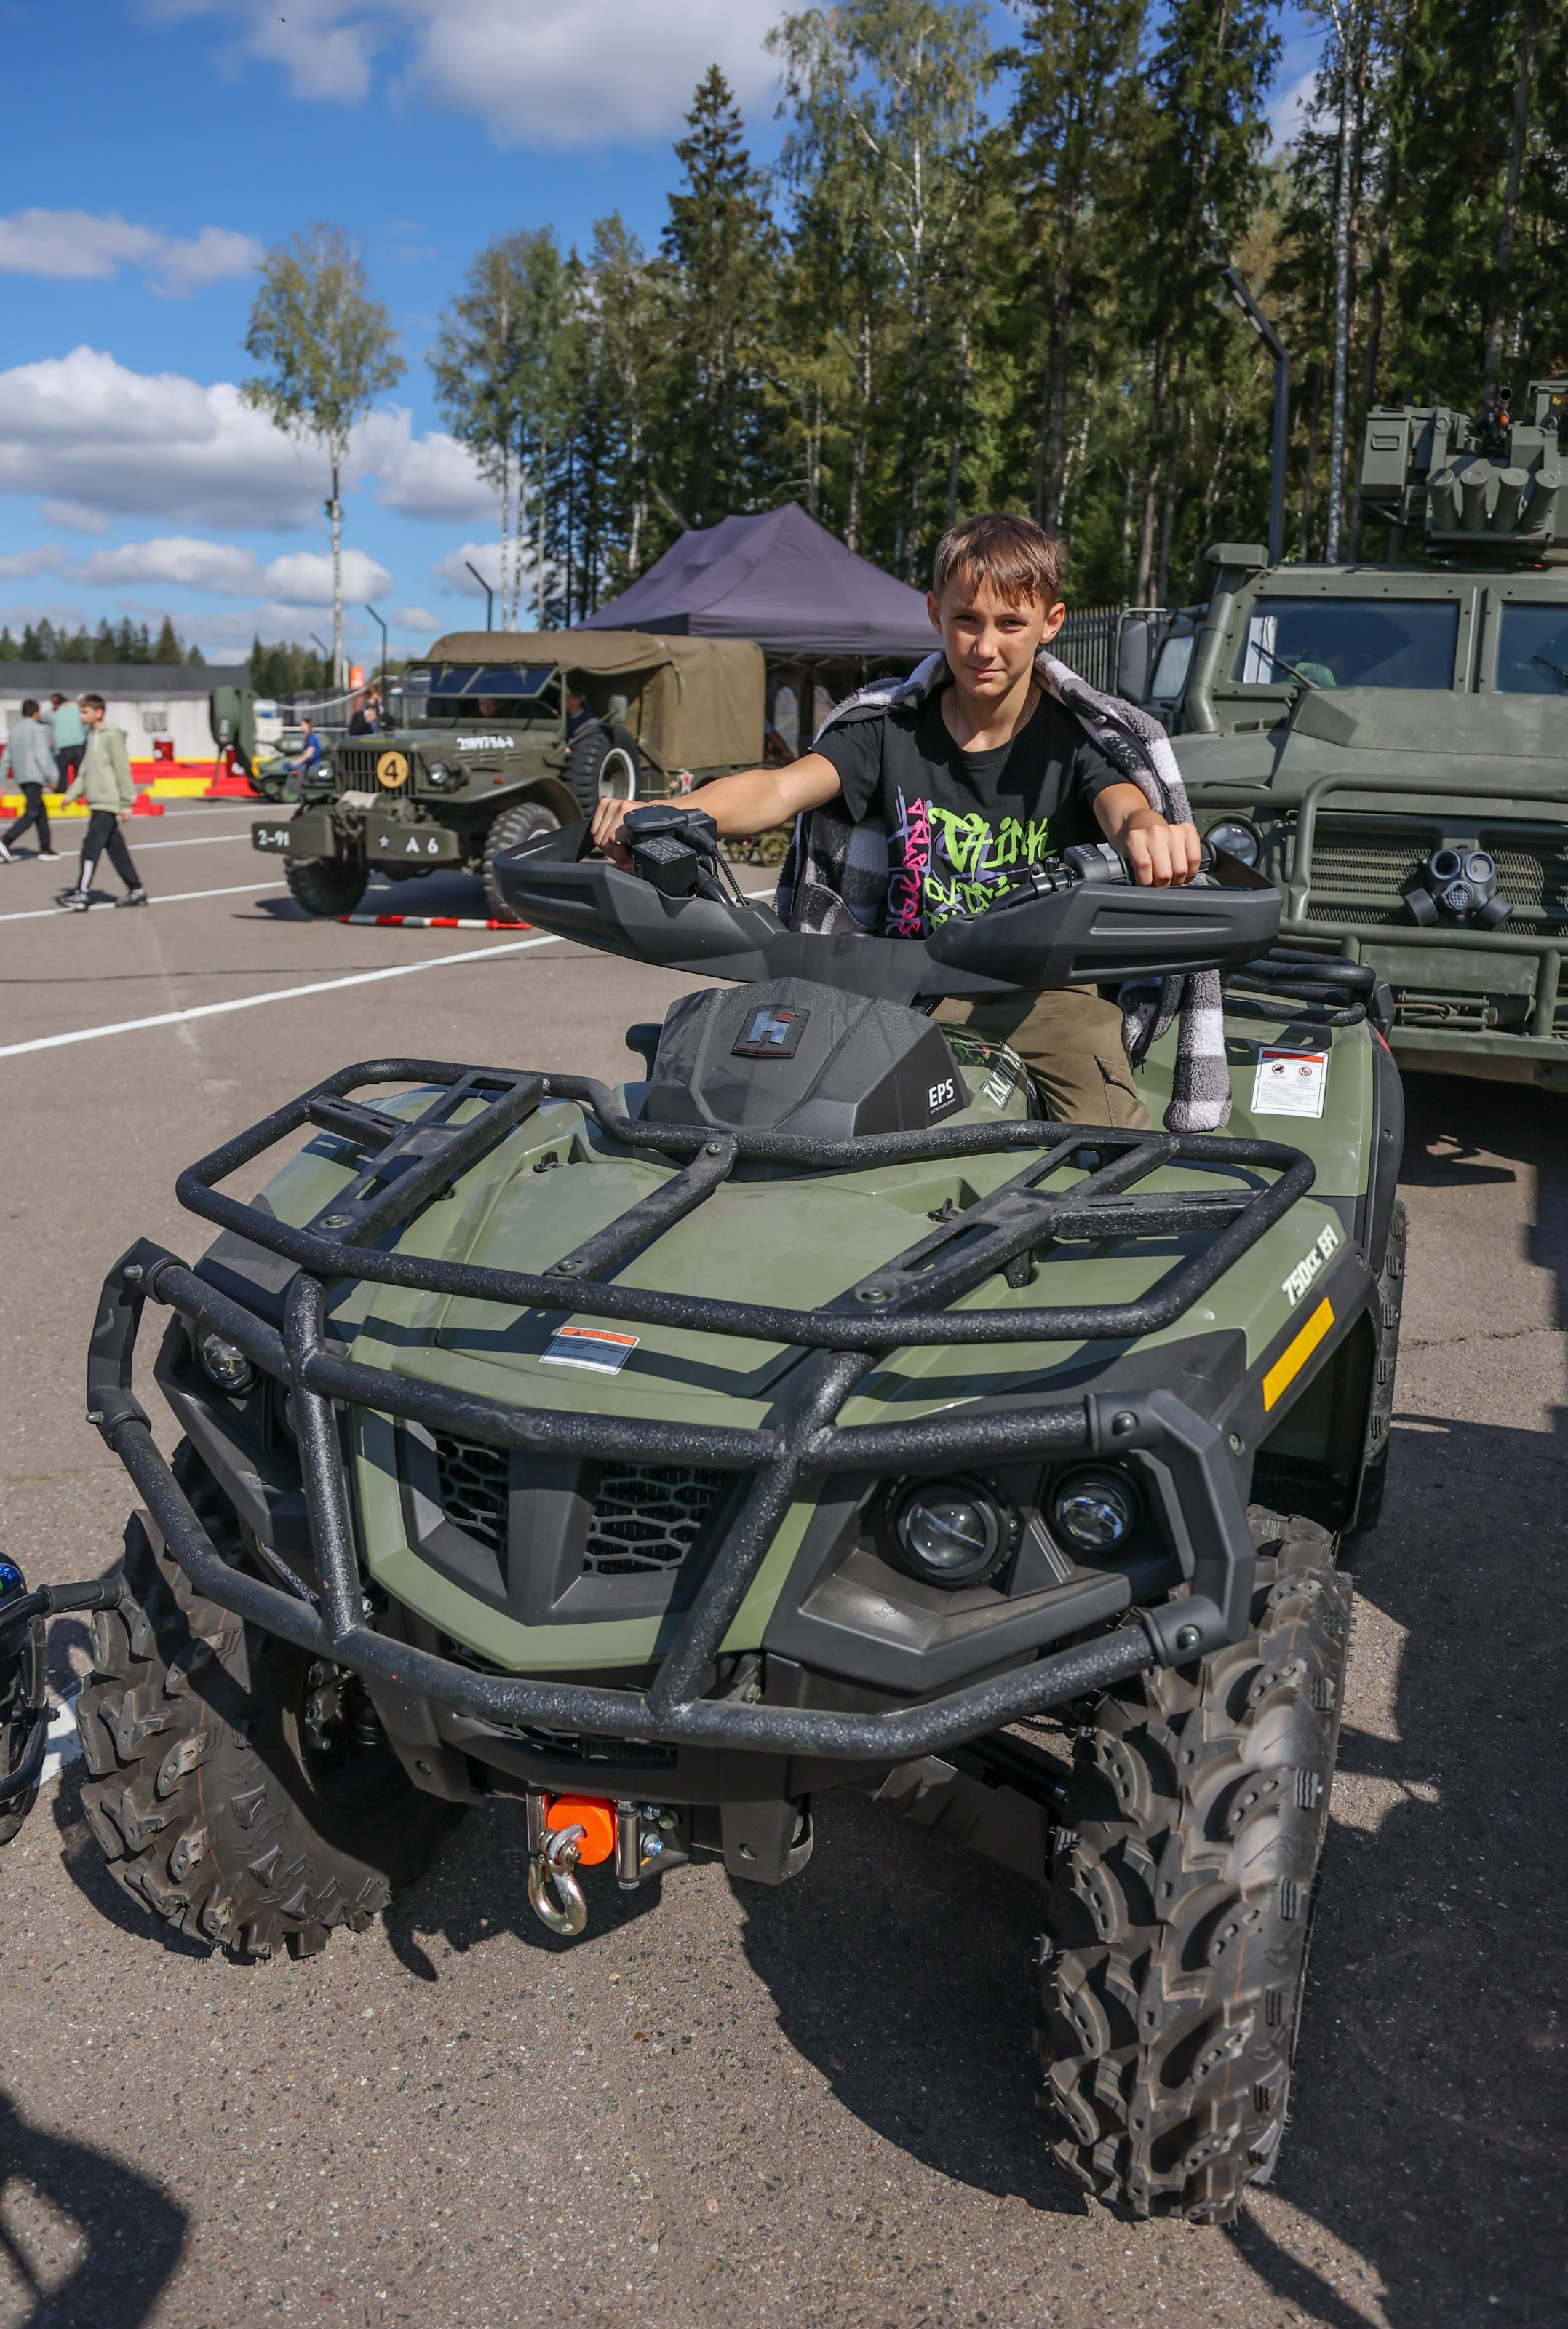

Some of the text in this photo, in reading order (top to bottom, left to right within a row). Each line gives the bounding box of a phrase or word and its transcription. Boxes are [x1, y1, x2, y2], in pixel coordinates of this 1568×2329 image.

[385, 759, 398, 780] 4
[405, 837, 439, 854] A 6
[928, 1078, 953, 1108] EPS
[1316, 1223, 1339, 1261] EFI
